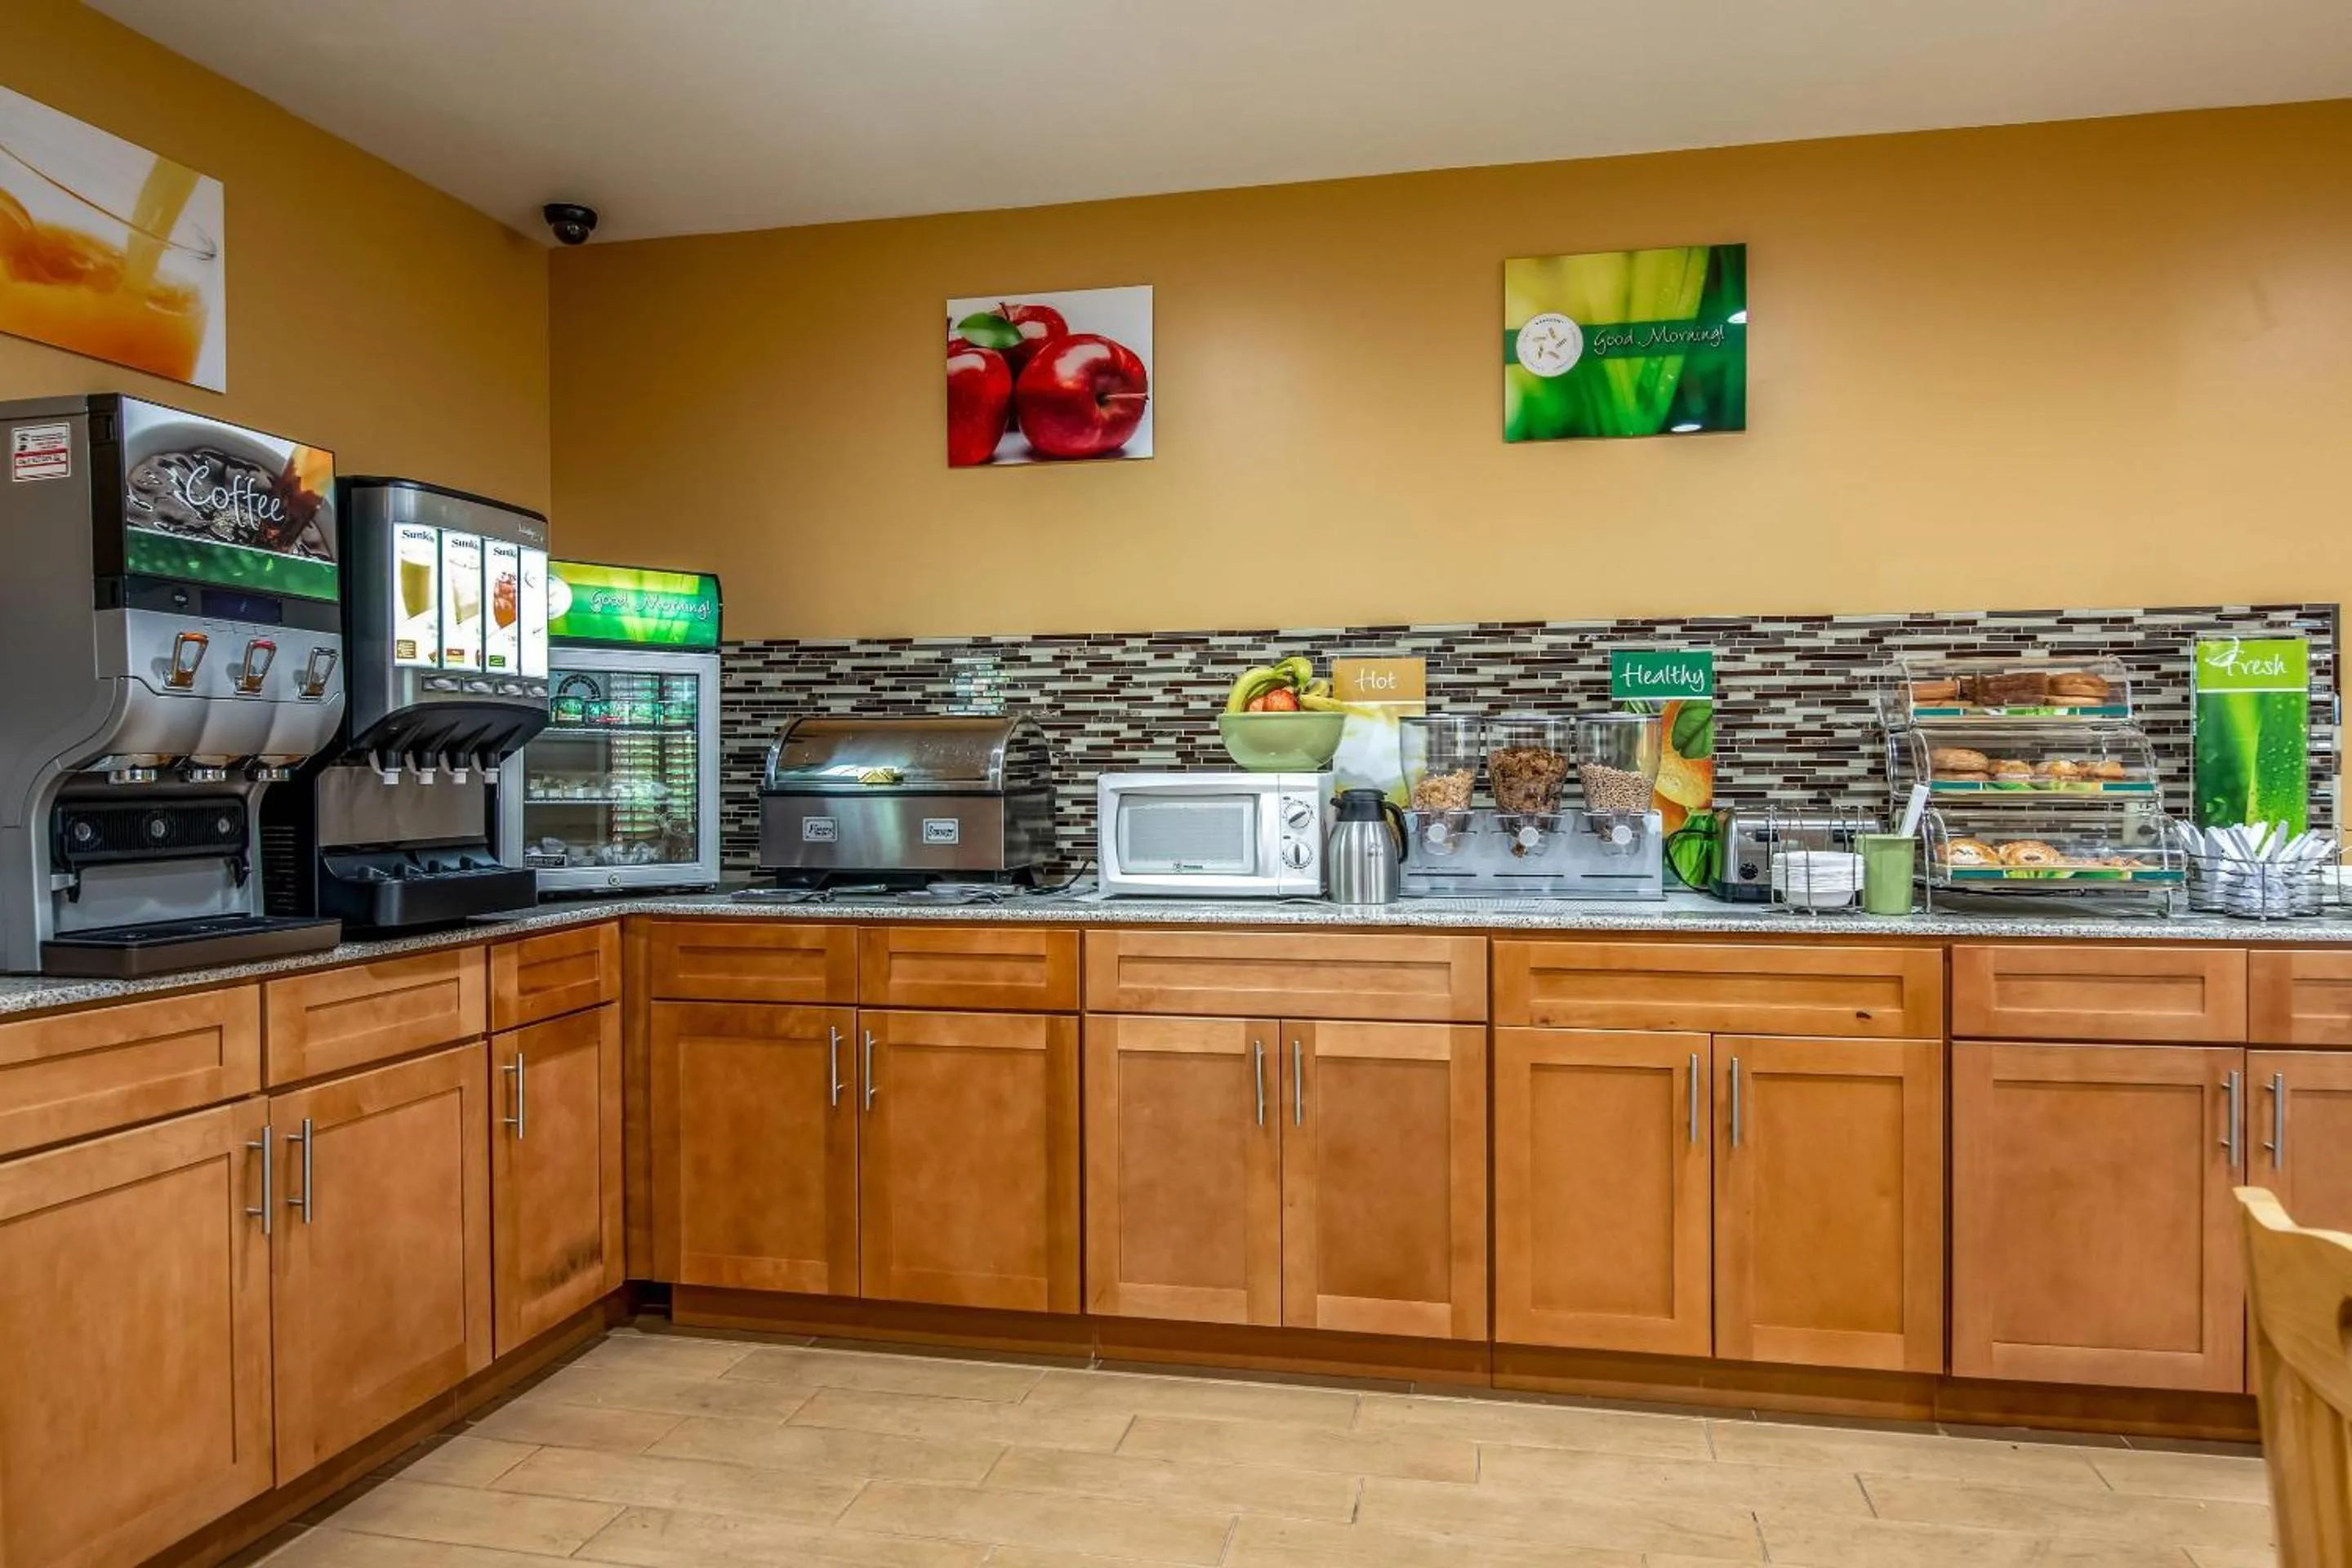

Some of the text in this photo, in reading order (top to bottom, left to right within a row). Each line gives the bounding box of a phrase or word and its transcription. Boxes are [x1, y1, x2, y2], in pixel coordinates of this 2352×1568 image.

[1593, 328, 1633, 355] Good
[1637, 325, 1724, 347] Morning!
[186, 466, 285, 531] Coffee
[590, 590, 710, 621] Good Morning!
[2205, 636, 2287, 676] Fresh
[1354, 667, 1396, 693] Hot
[1619, 662, 1705, 693] Healthy
